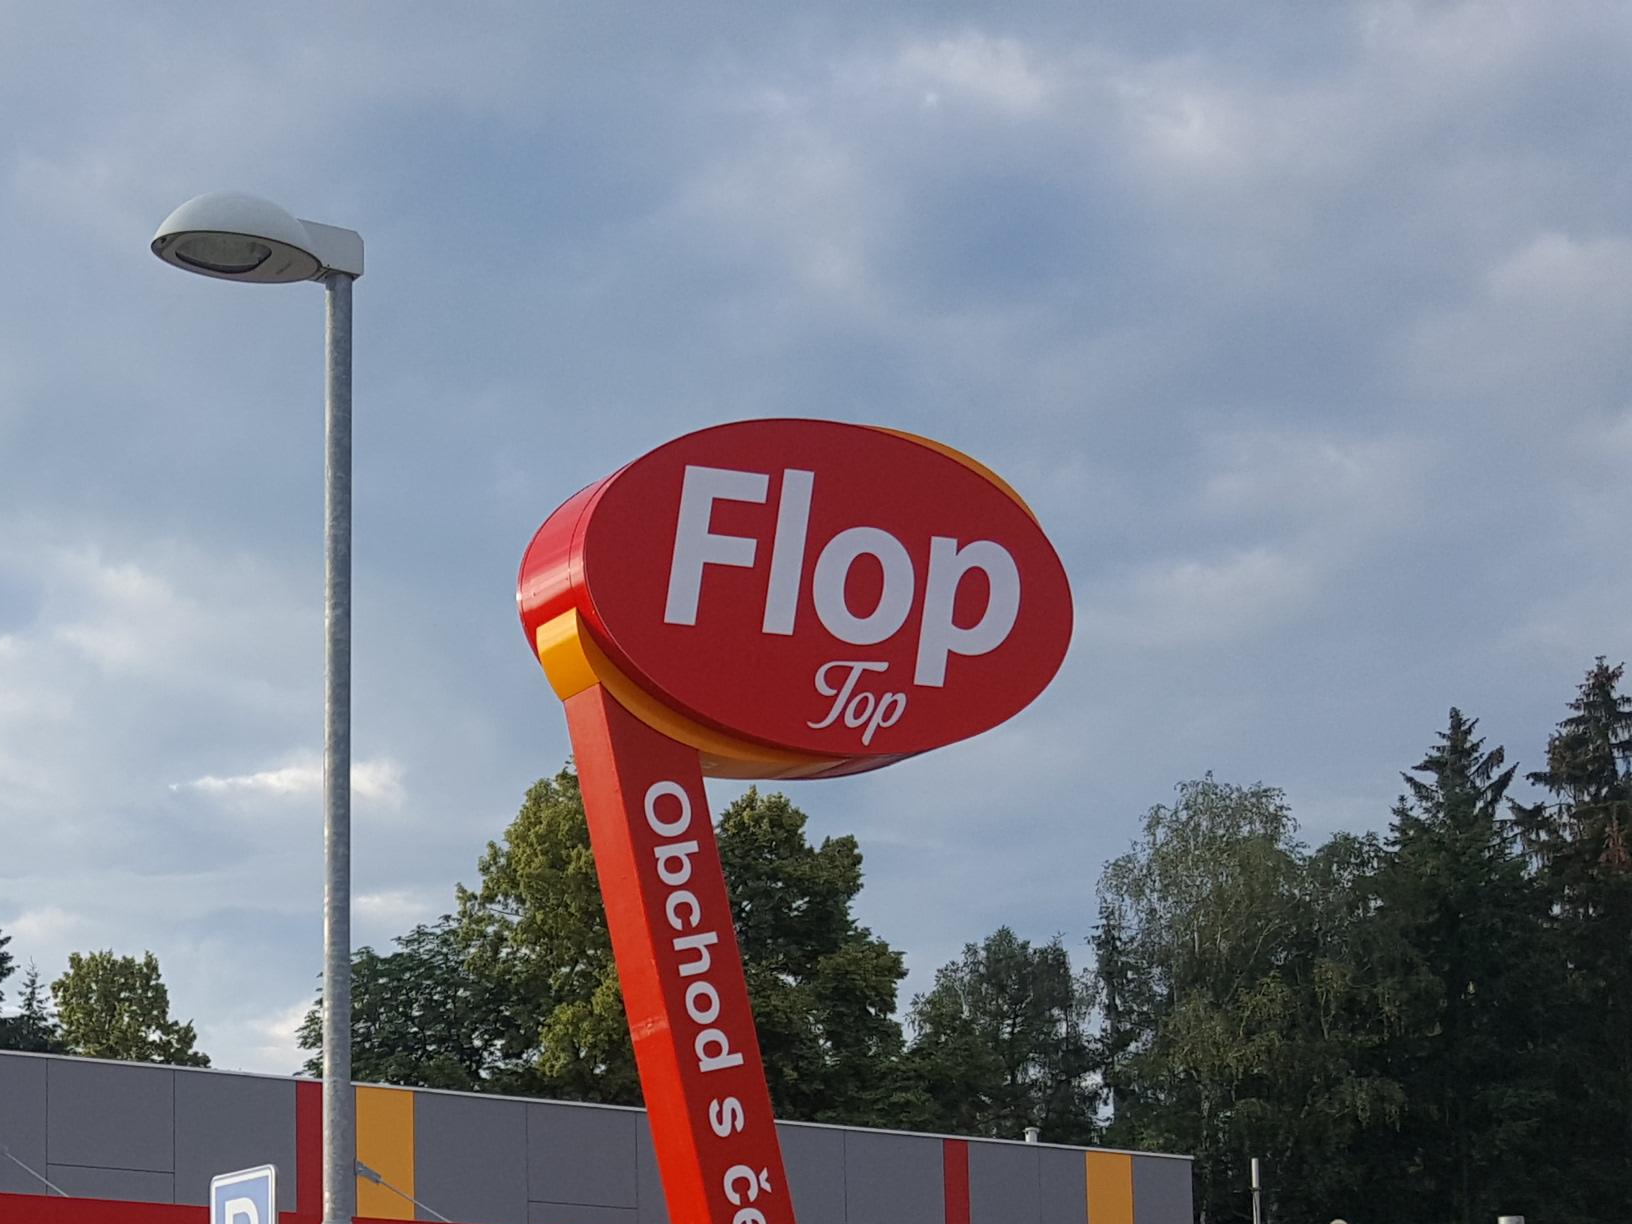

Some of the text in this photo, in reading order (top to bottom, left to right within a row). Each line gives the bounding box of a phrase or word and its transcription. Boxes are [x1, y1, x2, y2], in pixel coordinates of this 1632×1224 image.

[663, 464, 1021, 689] Flop
[806, 660, 907, 746] Top
[644, 780, 745, 1073] Obchod
[708, 1096, 745, 1138] s
